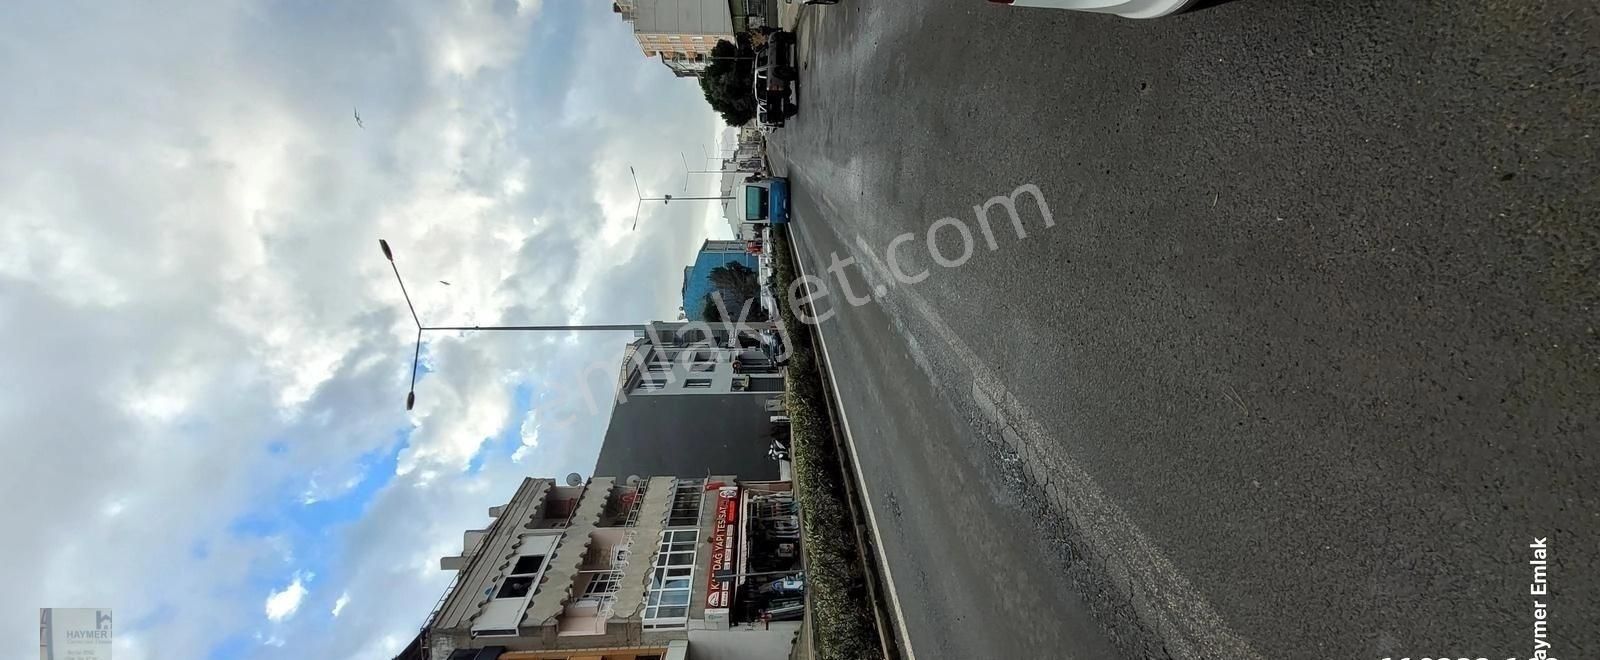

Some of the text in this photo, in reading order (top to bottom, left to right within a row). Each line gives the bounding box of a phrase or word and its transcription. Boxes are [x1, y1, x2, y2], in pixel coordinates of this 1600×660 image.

[716, 506, 727, 532] TESSAT
[714, 534, 725, 553] YAPI
[712, 553, 723, 571] DAĞ
